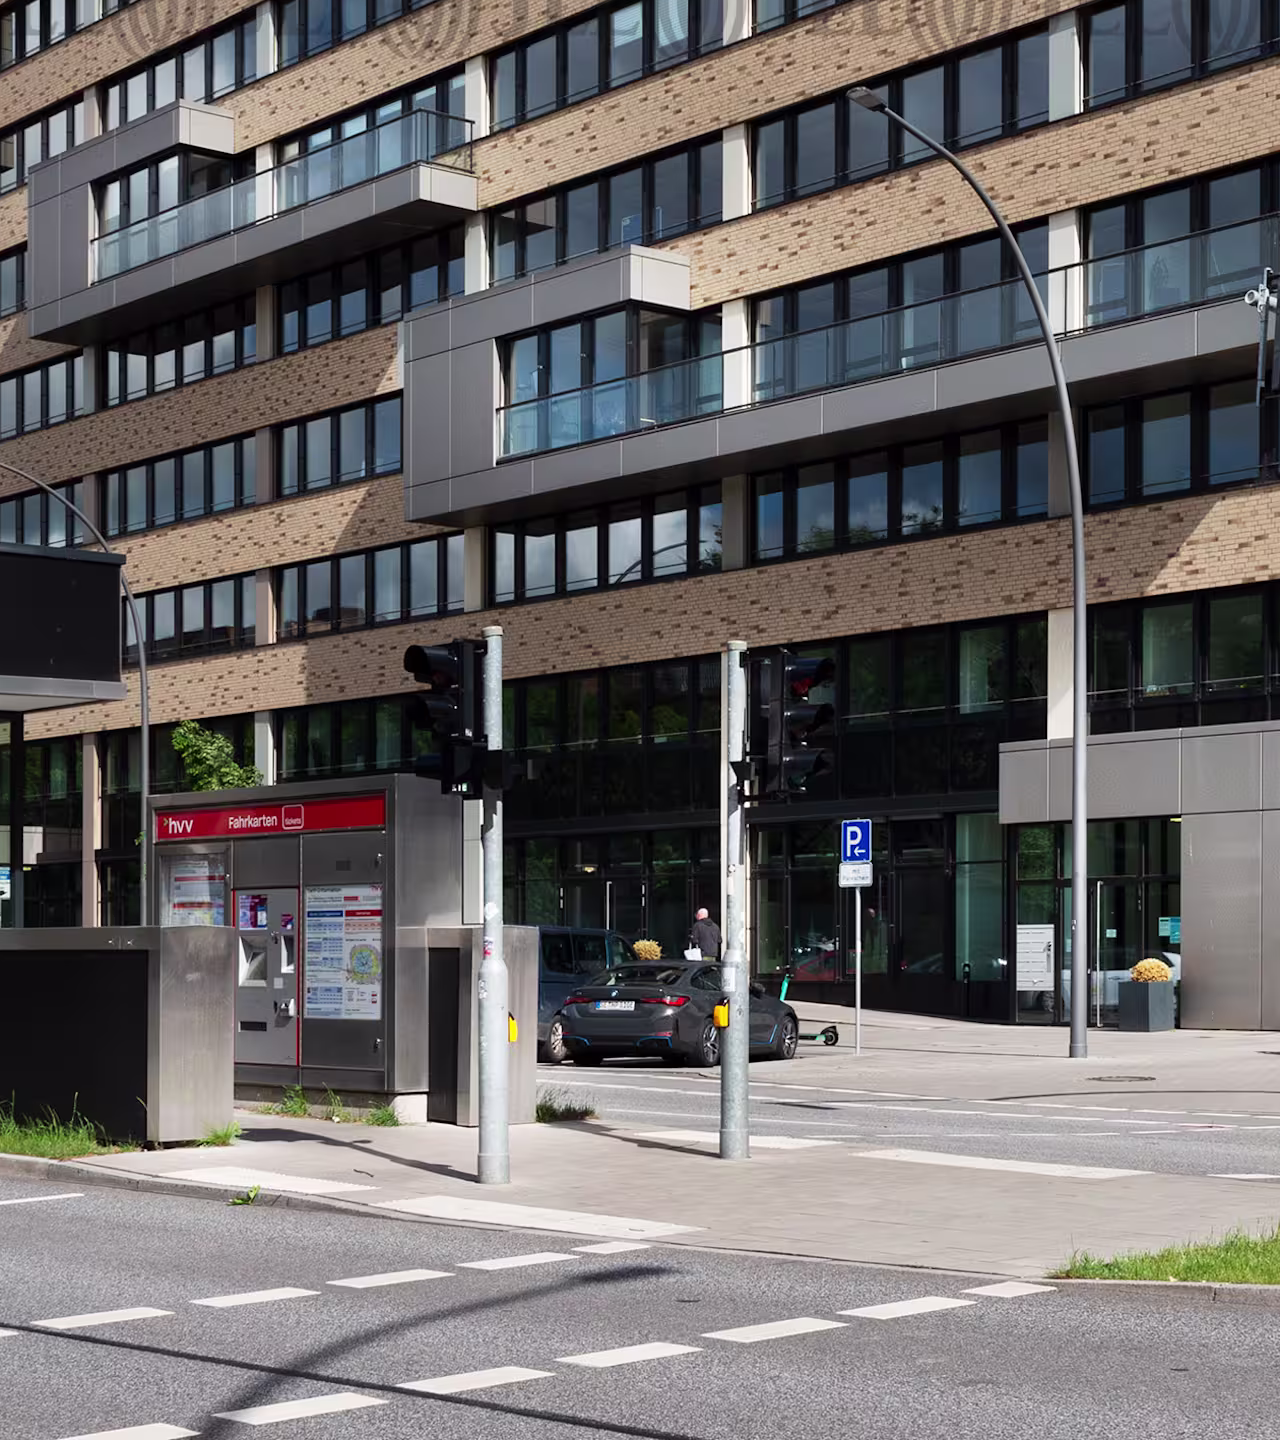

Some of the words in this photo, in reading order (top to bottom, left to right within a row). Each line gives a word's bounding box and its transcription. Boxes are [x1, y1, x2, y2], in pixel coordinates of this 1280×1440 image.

[168, 818, 194, 834] hvv
[228, 814, 278, 829] Fahrkarten
[846, 826, 862, 857] P
